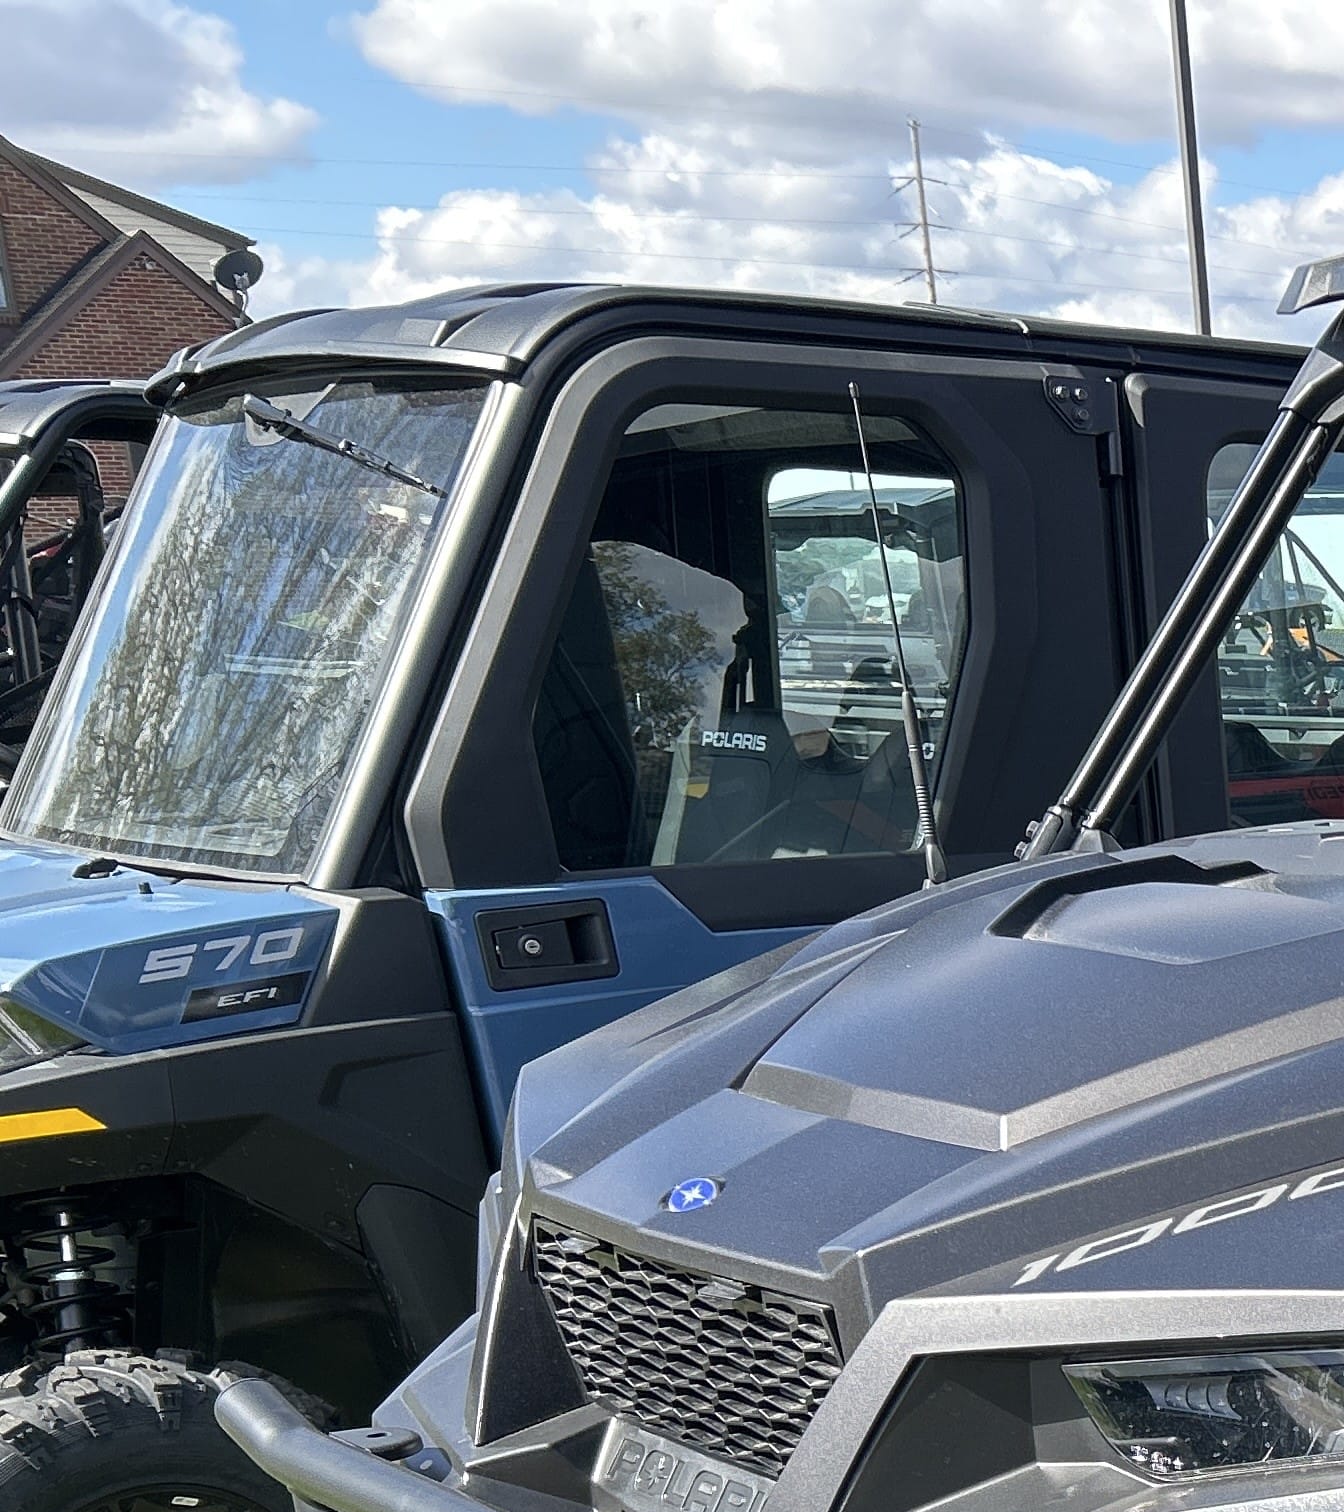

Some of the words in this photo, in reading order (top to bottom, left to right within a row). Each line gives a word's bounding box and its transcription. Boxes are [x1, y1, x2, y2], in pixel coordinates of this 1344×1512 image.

[701, 731, 768, 751] POLARIS
[138, 927, 304, 984] 570
[217, 987, 278, 1008] EFI
